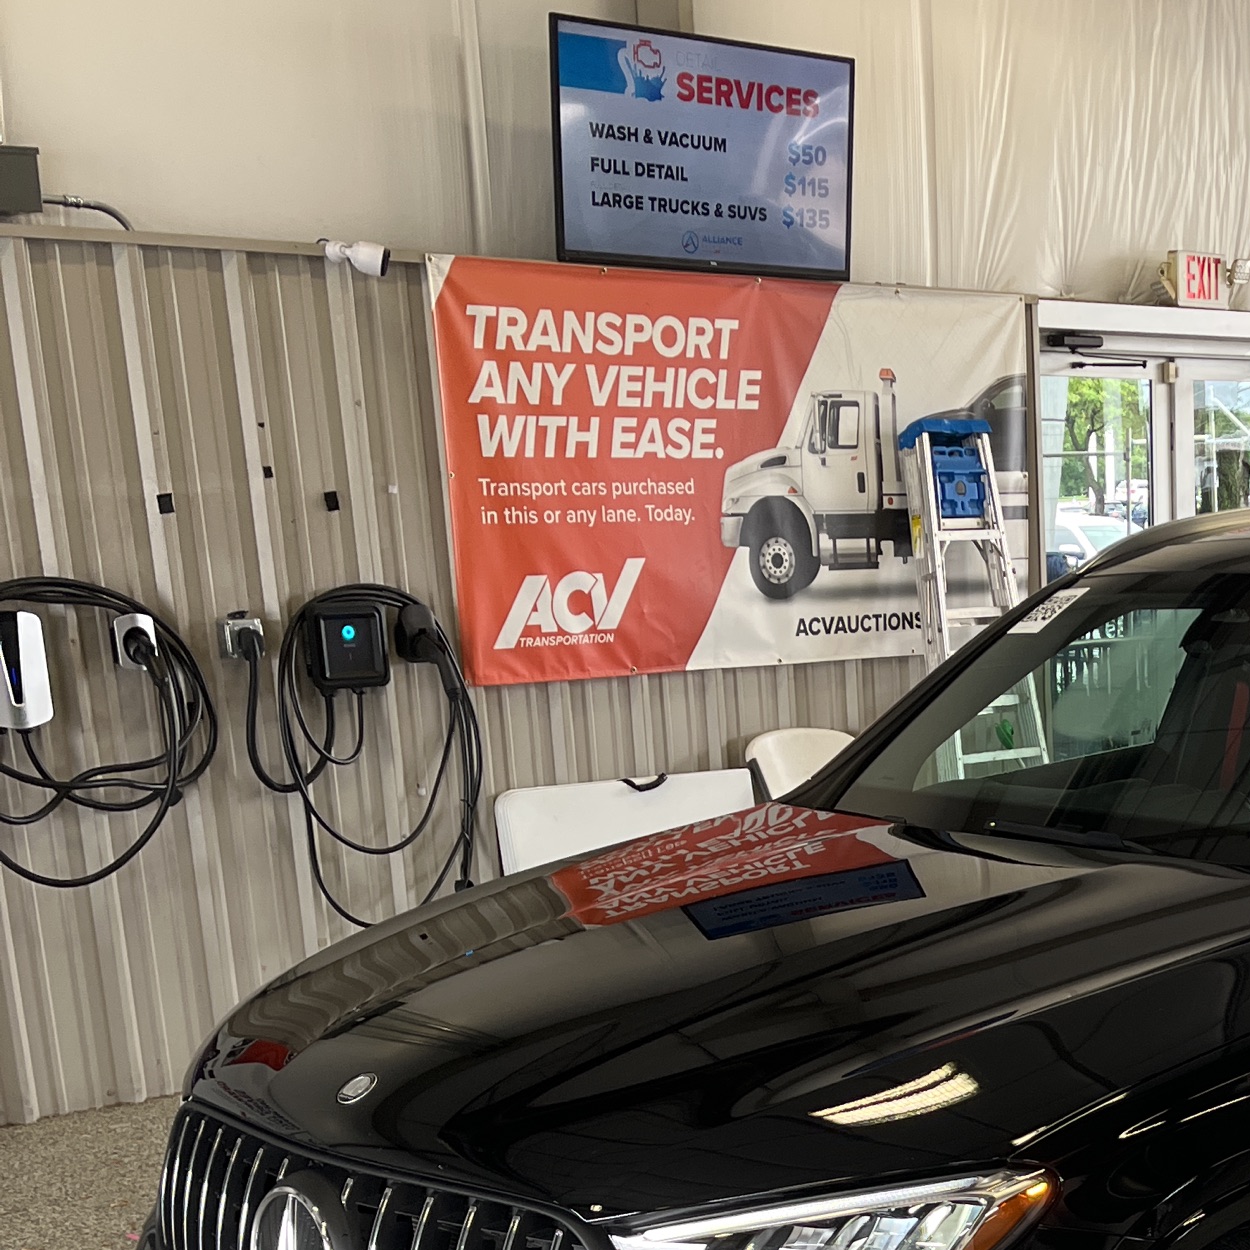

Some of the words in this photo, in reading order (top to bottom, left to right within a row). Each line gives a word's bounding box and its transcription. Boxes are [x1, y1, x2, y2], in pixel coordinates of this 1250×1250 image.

[676, 72, 819, 118] SERVICES
[589, 121, 639, 143] WASH
[643, 128, 654, 145] &
[657, 130, 727, 153] VACUUM
[788, 141, 827, 167] $50
[590, 157, 630, 176] FULL
[634, 161, 689, 182] DETAIL
[784, 171, 830, 198] $115
[591, 190, 644, 211] LARGE
[648, 197, 711, 217] TRUCKS
[714, 203, 724, 219] &
[727, 204, 768, 222] SUVS
[782, 204, 830, 230] $135
[702, 234, 743, 247] ALLIANCE
[1186, 254, 1221, 300] EXIT
[466, 304, 739, 360] TRANSPORT
[468, 360, 577, 406] ANY
[585, 364, 762, 410] VEHICLE
[477, 414, 600, 458] WITH
[611, 416, 724, 459] EASE.
[478, 478, 567, 500] Transport
[571, 481, 607, 496] cars
[612, 478, 695, 499] purchased
[481, 506, 498, 525] in
[503, 506, 538, 524] this
[543, 509, 561, 524] or
[566, 509, 597, 527] any
[601, 505, 641, 523] lane.
[644, 504, 695, 525] Today.
[493, 557, 646, 650] ACV
[795, 612, 922, 637] ACVAUCTIONS
[519, 633, 615, 648] TRANSPORTATION
